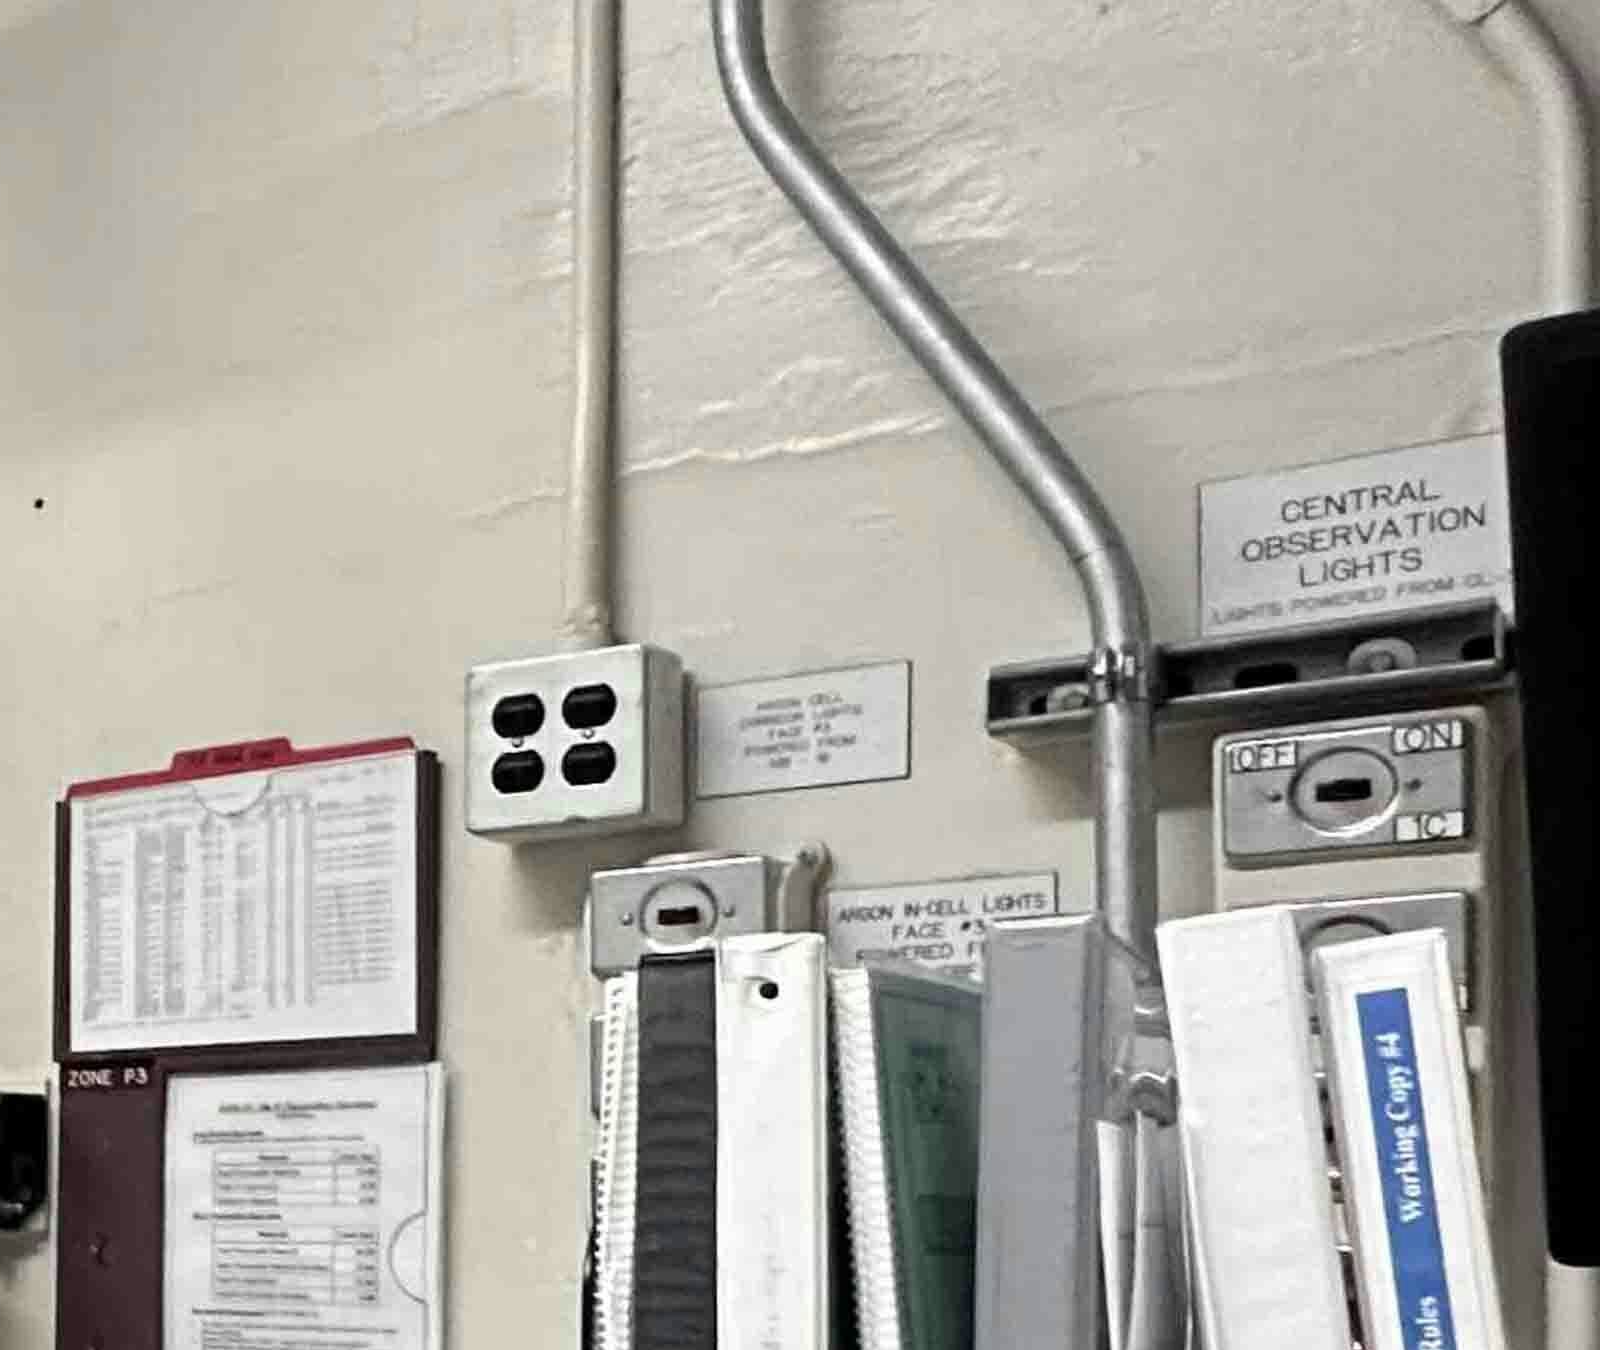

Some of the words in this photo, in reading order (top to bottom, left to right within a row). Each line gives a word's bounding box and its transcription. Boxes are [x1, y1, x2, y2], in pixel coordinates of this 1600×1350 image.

[1281, 480, 1440, 524] CENTRAL
[1240, 502, 1487, 563] OBSERVATION
[1298, 547, 1423, 588] LIGHTS
[1396, 577, 1455, 598] FROM
[1403, 723, 1454, 752] ON
[1236, 744, 1292, 771] OFF
[837, 905, 894, 924] ARGON
[904, 898, 969, 918] IN-CELL
[983, 892, 1049, 914] LIGHTS
[891, 923, 945, 942] FACE
[1374, 1031, 1403, 1058] #4
[67, 1068, 113, 1088] ZONE
[123, 1066, 149, 1085] P3
[1385, 1064, 1414, 1123] Copy
[1393, 1123, 1425, 1225] Working
